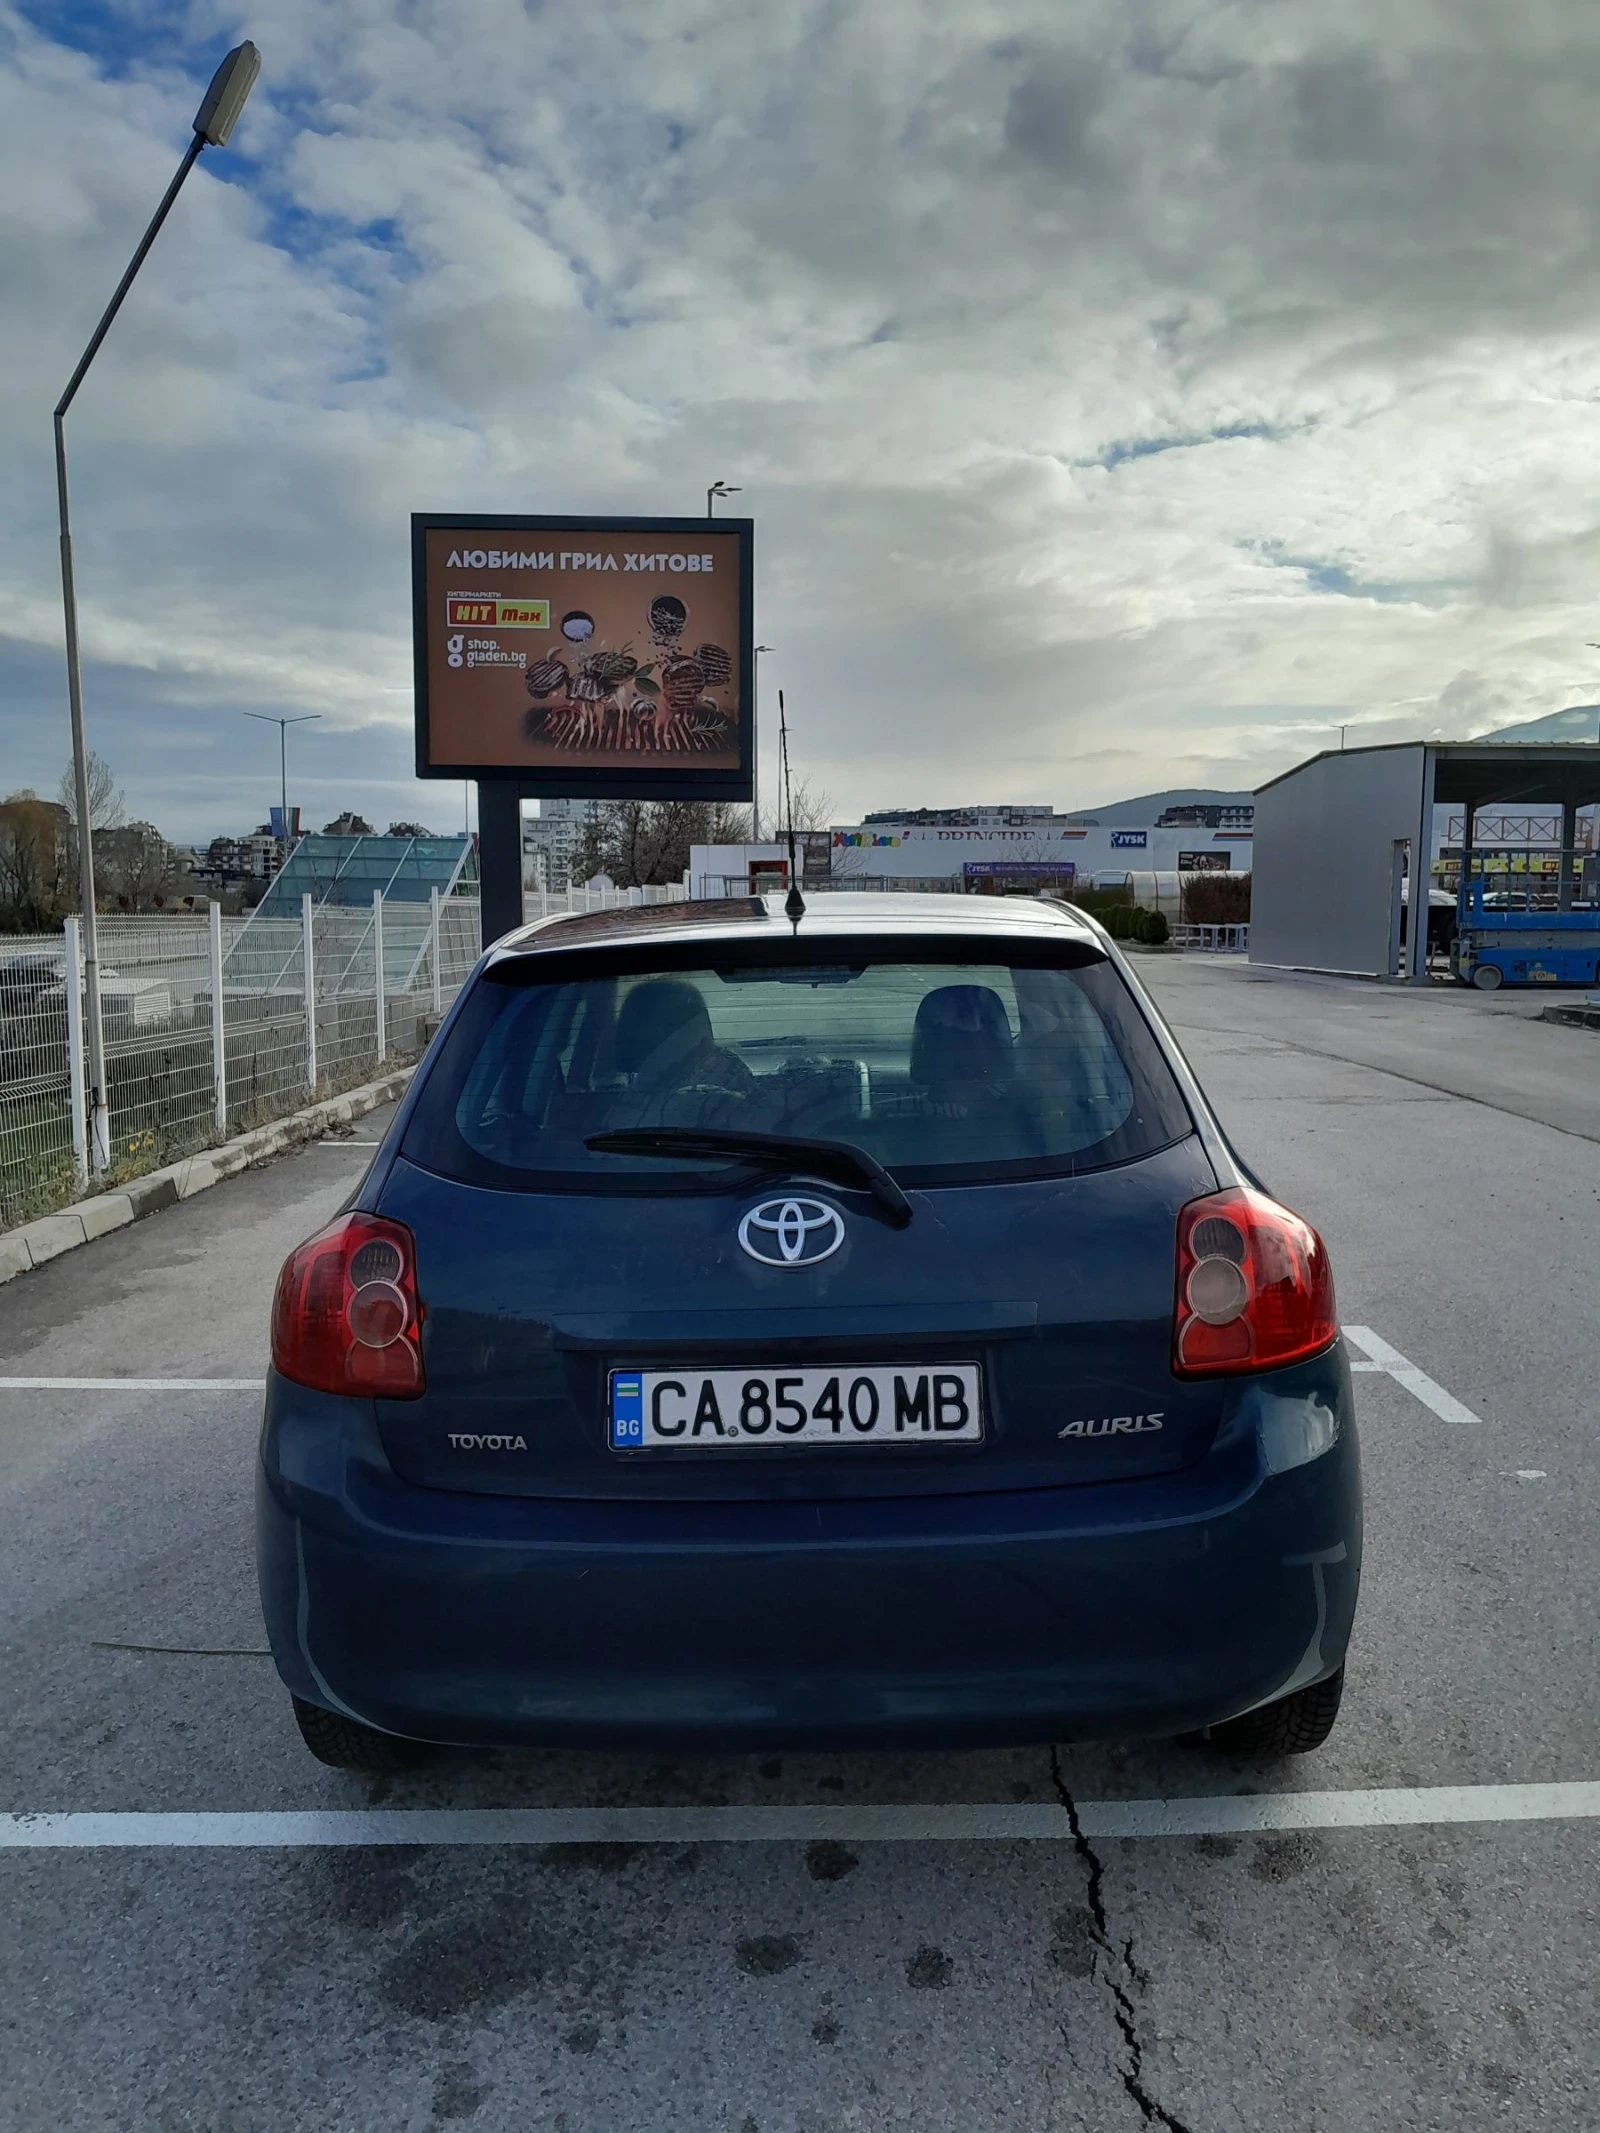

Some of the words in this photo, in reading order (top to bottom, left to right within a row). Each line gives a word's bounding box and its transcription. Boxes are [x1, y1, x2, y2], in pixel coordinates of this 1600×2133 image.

[446, 550, 554, 570] ЛЮБИМИ
[560, 552, 618, 571] ГРИЛ
[623, 553, 714, 573] ХИТОВЕ
[456, 605, 492, 621] HIT
[467, 639, 501, 651] shop.
[466, 651, 527, 669] gladen.bg
[1117, 834, 1146, 845] JYSK
[651, 1379, 726, 1437] CA
[738, 1376, 880, 1435] 8540
[893, 1373, 970, 1432] MB
[616, 1419, 640, 1437] BG
[1057, 1412, 1165, 1439] AURIS
[447, 1433, 529, 1451] TOYOTA
